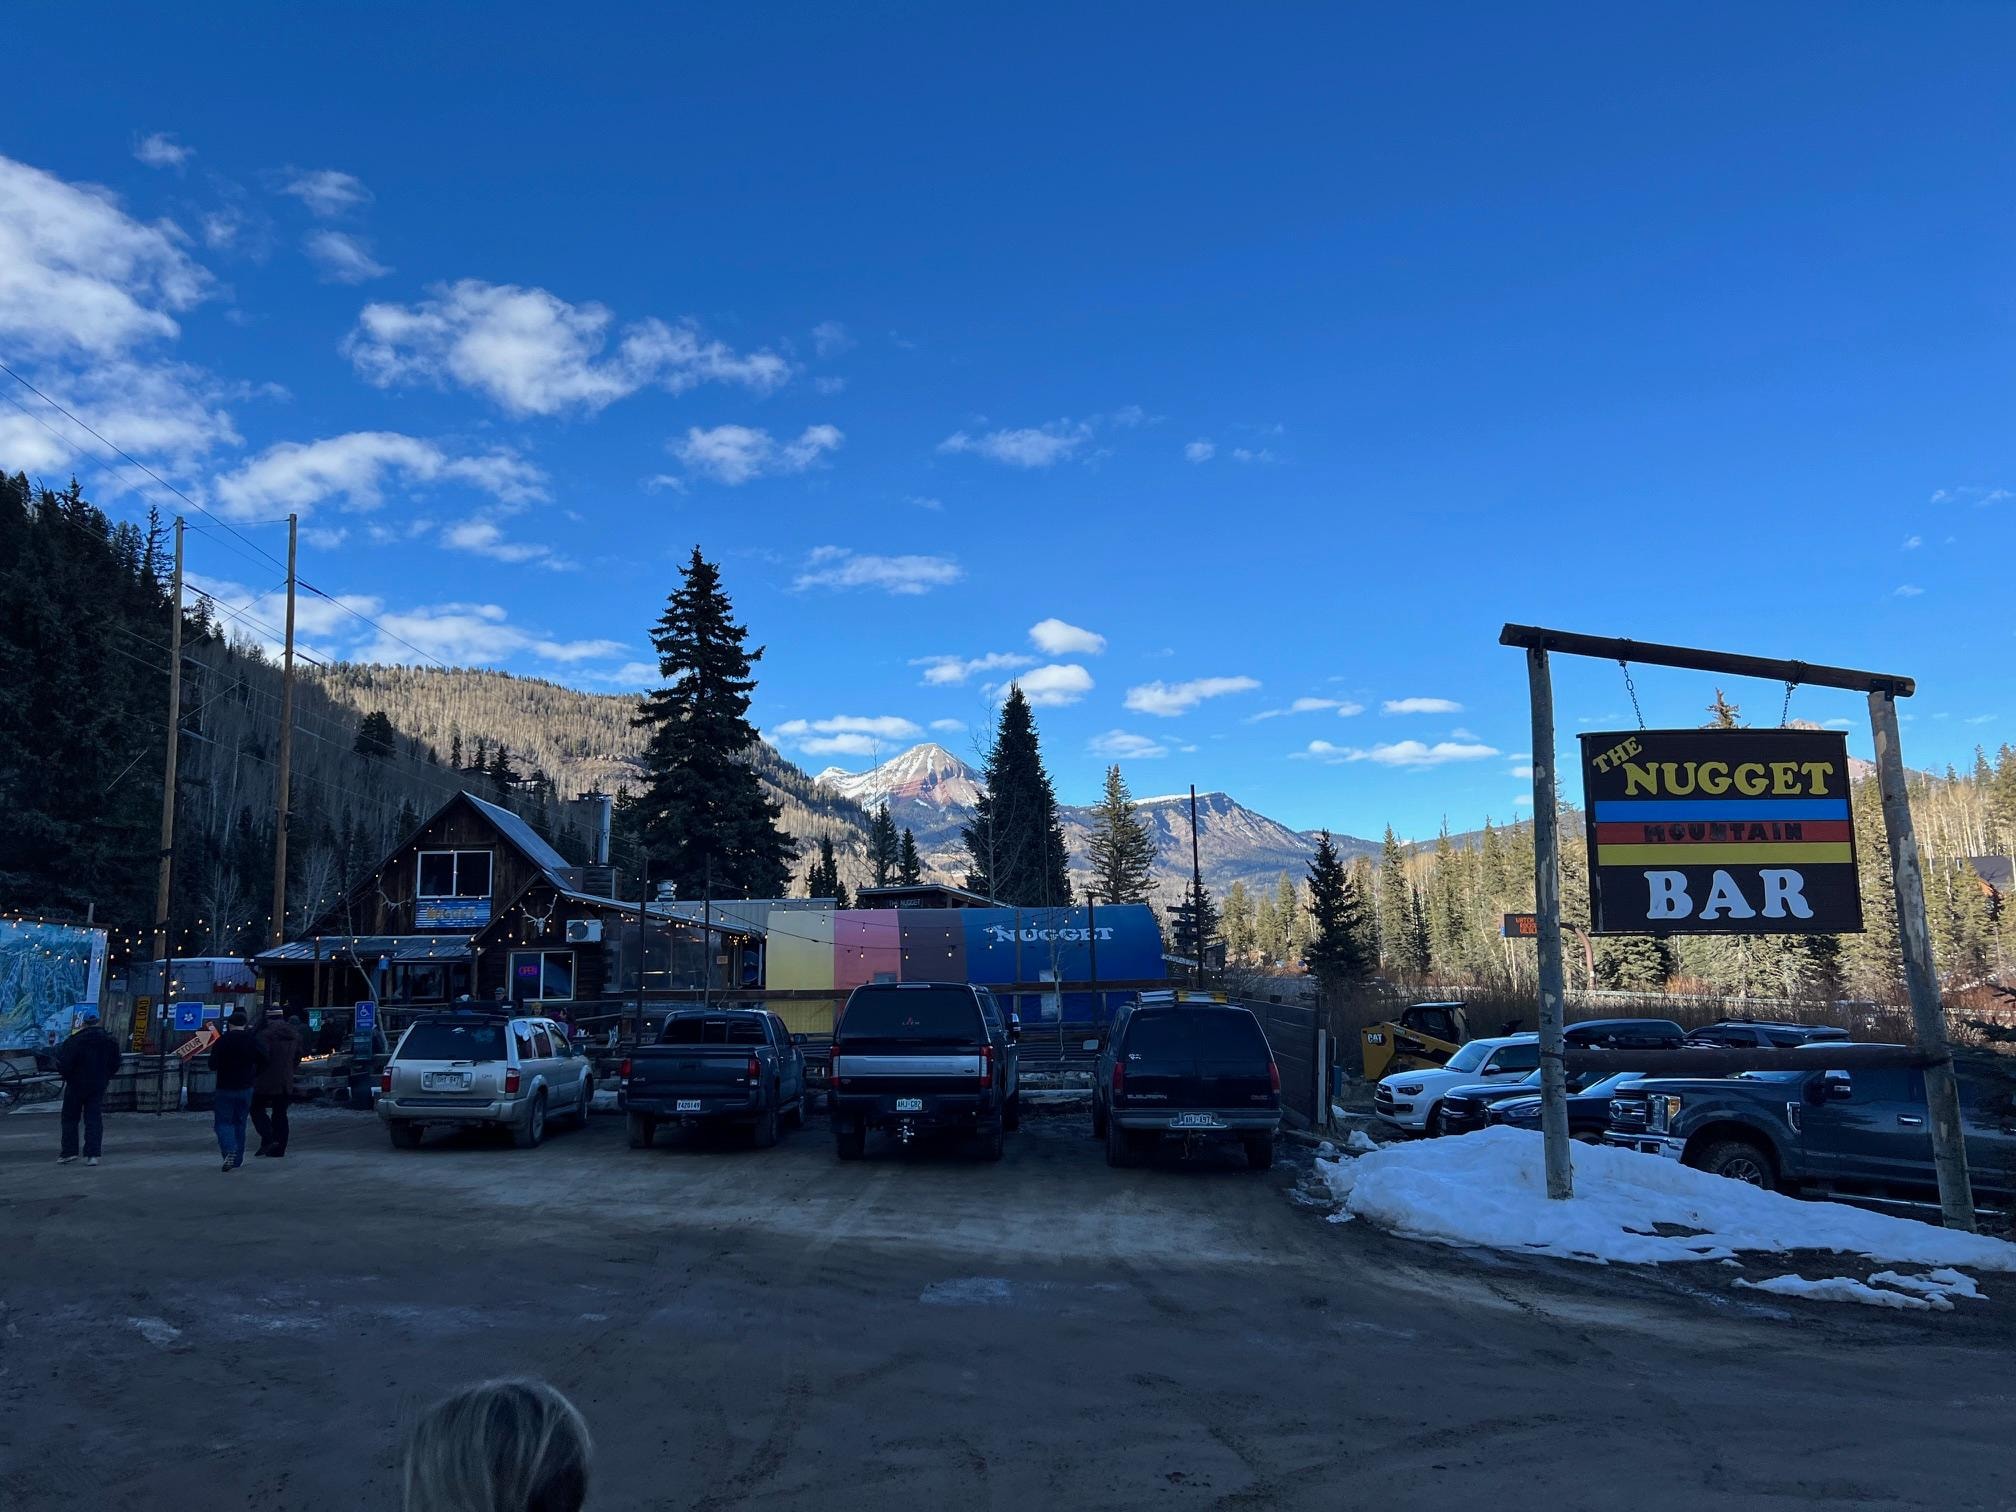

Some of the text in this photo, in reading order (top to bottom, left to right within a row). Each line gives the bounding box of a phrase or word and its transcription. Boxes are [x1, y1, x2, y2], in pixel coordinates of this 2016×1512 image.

[1592, 735, 1643, 774] THE
[1622, 761, 1834, 797] NUGGET
[1643, 822, 1803, 842] MOUNTAIN
[1643, 868, 1815, 920] BAR
[996, 927, 1114, 942] NUGGET
[1367, 1033, 1382, 1044] CAT
